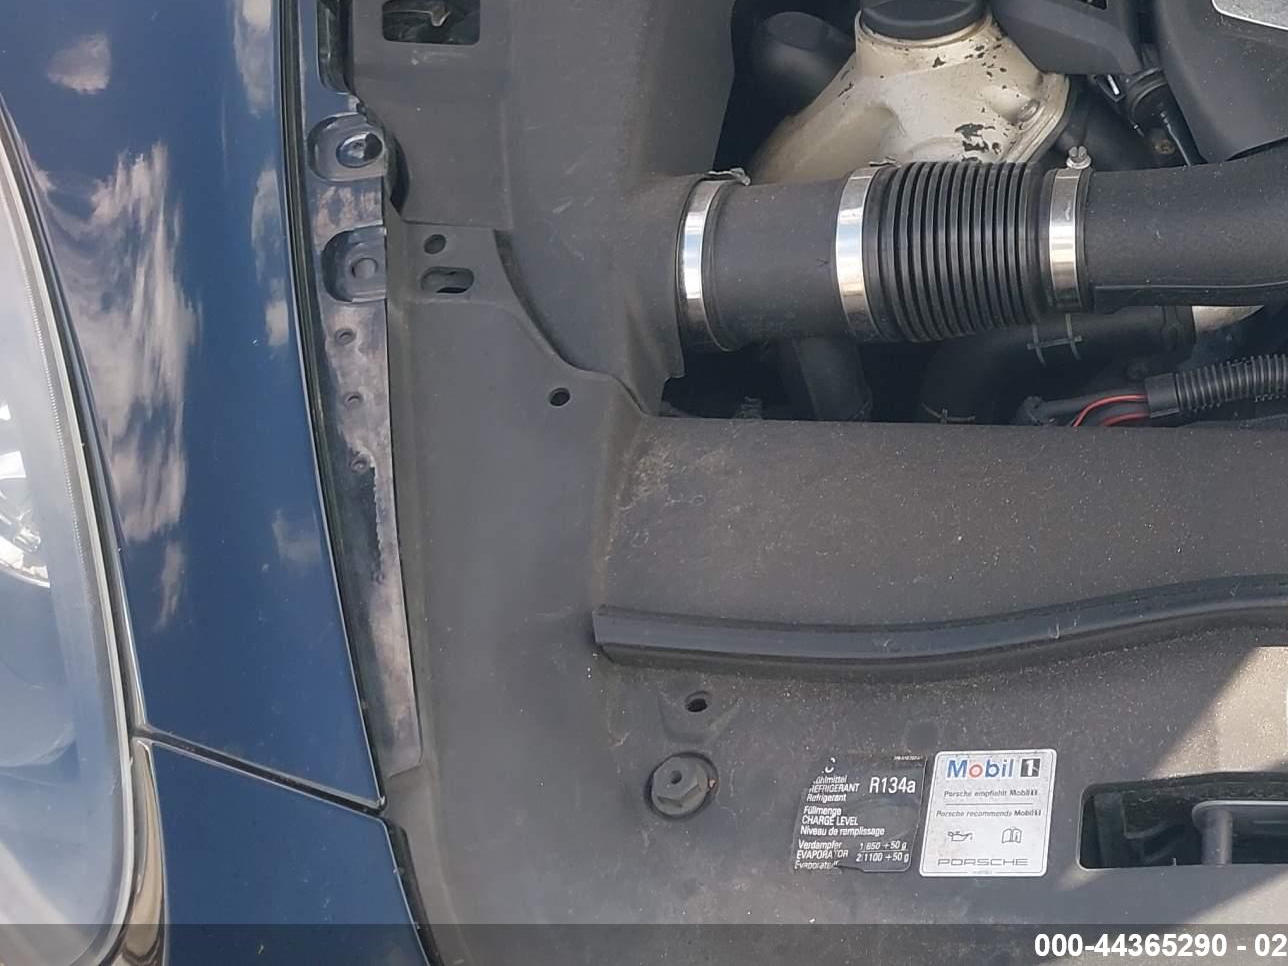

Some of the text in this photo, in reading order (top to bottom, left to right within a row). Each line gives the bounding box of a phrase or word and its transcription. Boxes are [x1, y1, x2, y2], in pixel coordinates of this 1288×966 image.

[945, 758, 1015, 779] Mobil
[808, 783, 861, 794] REFRIGERANT
[868, 777, 917, 795] R134a
[944, 789, 972, 798] Porsche
[803, 805, 842, 819] Füllmenge
[801, 814, 859, 826] CHARGE LEVEL
[800, 825, 885, 838] Niveau de remplissage
[798, 838, 843, 850] Verdampfer
[937, 858, 1029, 867] PORSCHE
